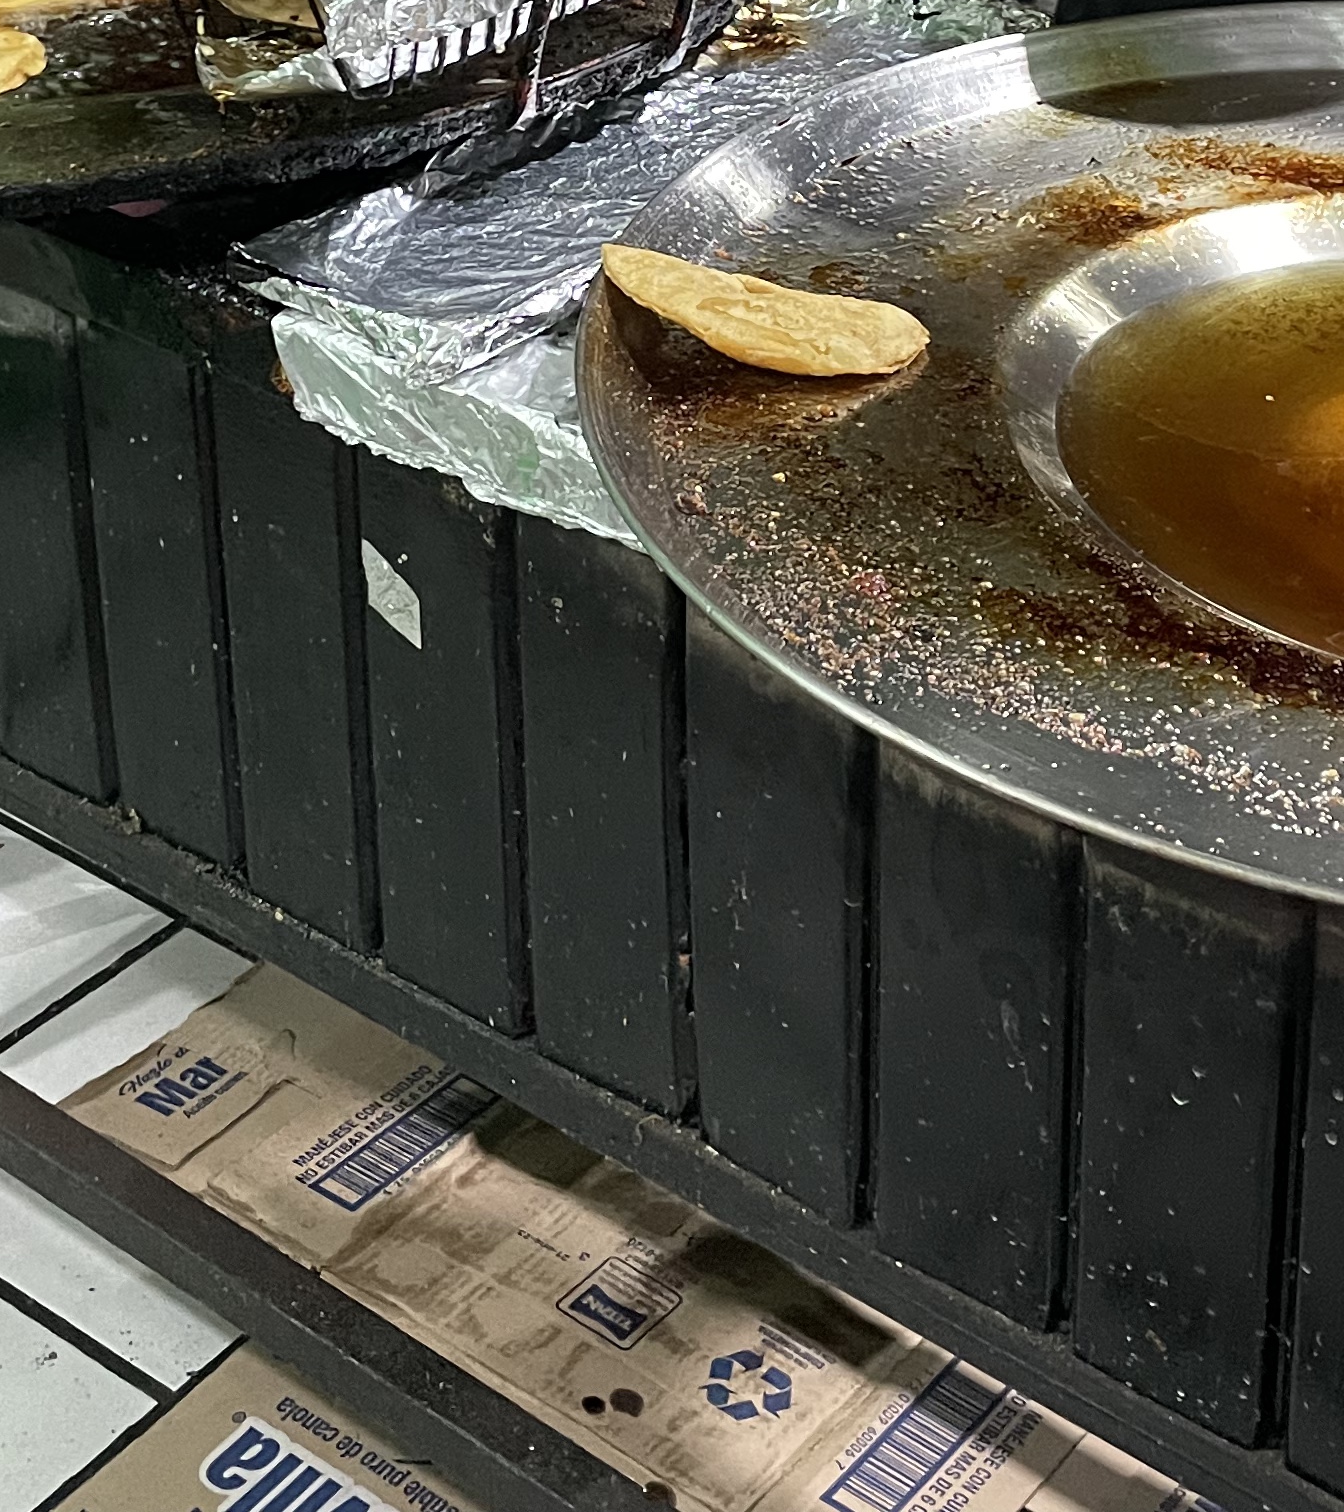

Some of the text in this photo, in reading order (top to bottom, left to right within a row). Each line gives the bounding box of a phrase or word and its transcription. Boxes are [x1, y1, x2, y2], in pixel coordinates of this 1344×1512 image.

[355, 1100, 383, 1121] CON
[380, 1064, 432, 1103] CUIDADO
[295, 1168, 318, 1185] NO
[315, 1131, 369, 1170] ESTIBAR
[582, 1295, 632, 1331] TITAN
[1011, 1395, 1027, 1408] O
[276, 1396, 340, 1443] canola
[968, 1406, 1018, 1453] ESTIBAR
[336, 1434, 364, 1458] de
[359, 1450, 412, 1488] puro
[944, 1449, 977, 1480] MAS
[961, 1467, 992, 1494] CON
[920, 1494, 937, 1506] 6
[928, 1476, 953, 1497] DE
